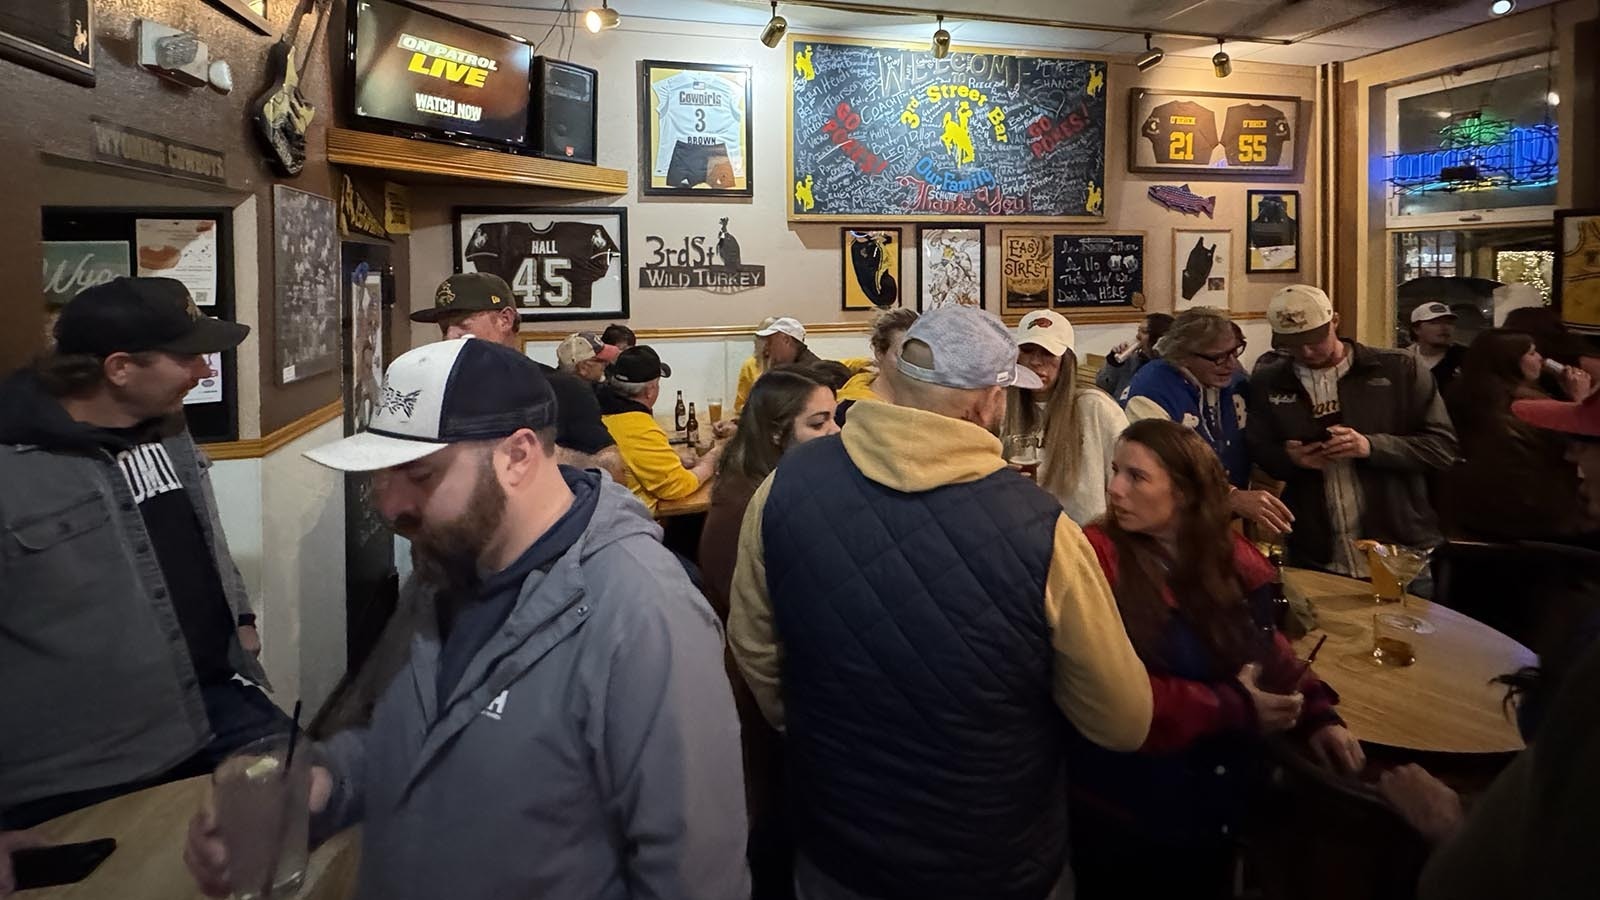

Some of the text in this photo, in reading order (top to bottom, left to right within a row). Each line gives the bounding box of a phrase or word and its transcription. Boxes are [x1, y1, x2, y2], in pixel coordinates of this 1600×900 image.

[401, 36, 498, 71] ON PATROL
[407, 52, 489, 88] LIVE
[415, 92, 483, 122] WATCH NOW
[679, 90, 722, 106] Cowgirls
[694, 108, 706, 132] 3
[926, 84, 989, 109] Street
[987, 106, 1009, 143] Bar
[687, 136, 717, 145] BROWN
[1168, 131, 1195, 161] 21
[1237, 134, 1268, 162] 55
[915, 156, 944, 187] Our
[942, 168, 997, 193] Family
[531, 240, 558, 255] HALL
[1009, 238, 1041, 259] EASY
[645, 268, 761, 287] WILD TURKEY
[1003, 256, 1051, 279] STREET
[512, 257, 573, 307] 45
